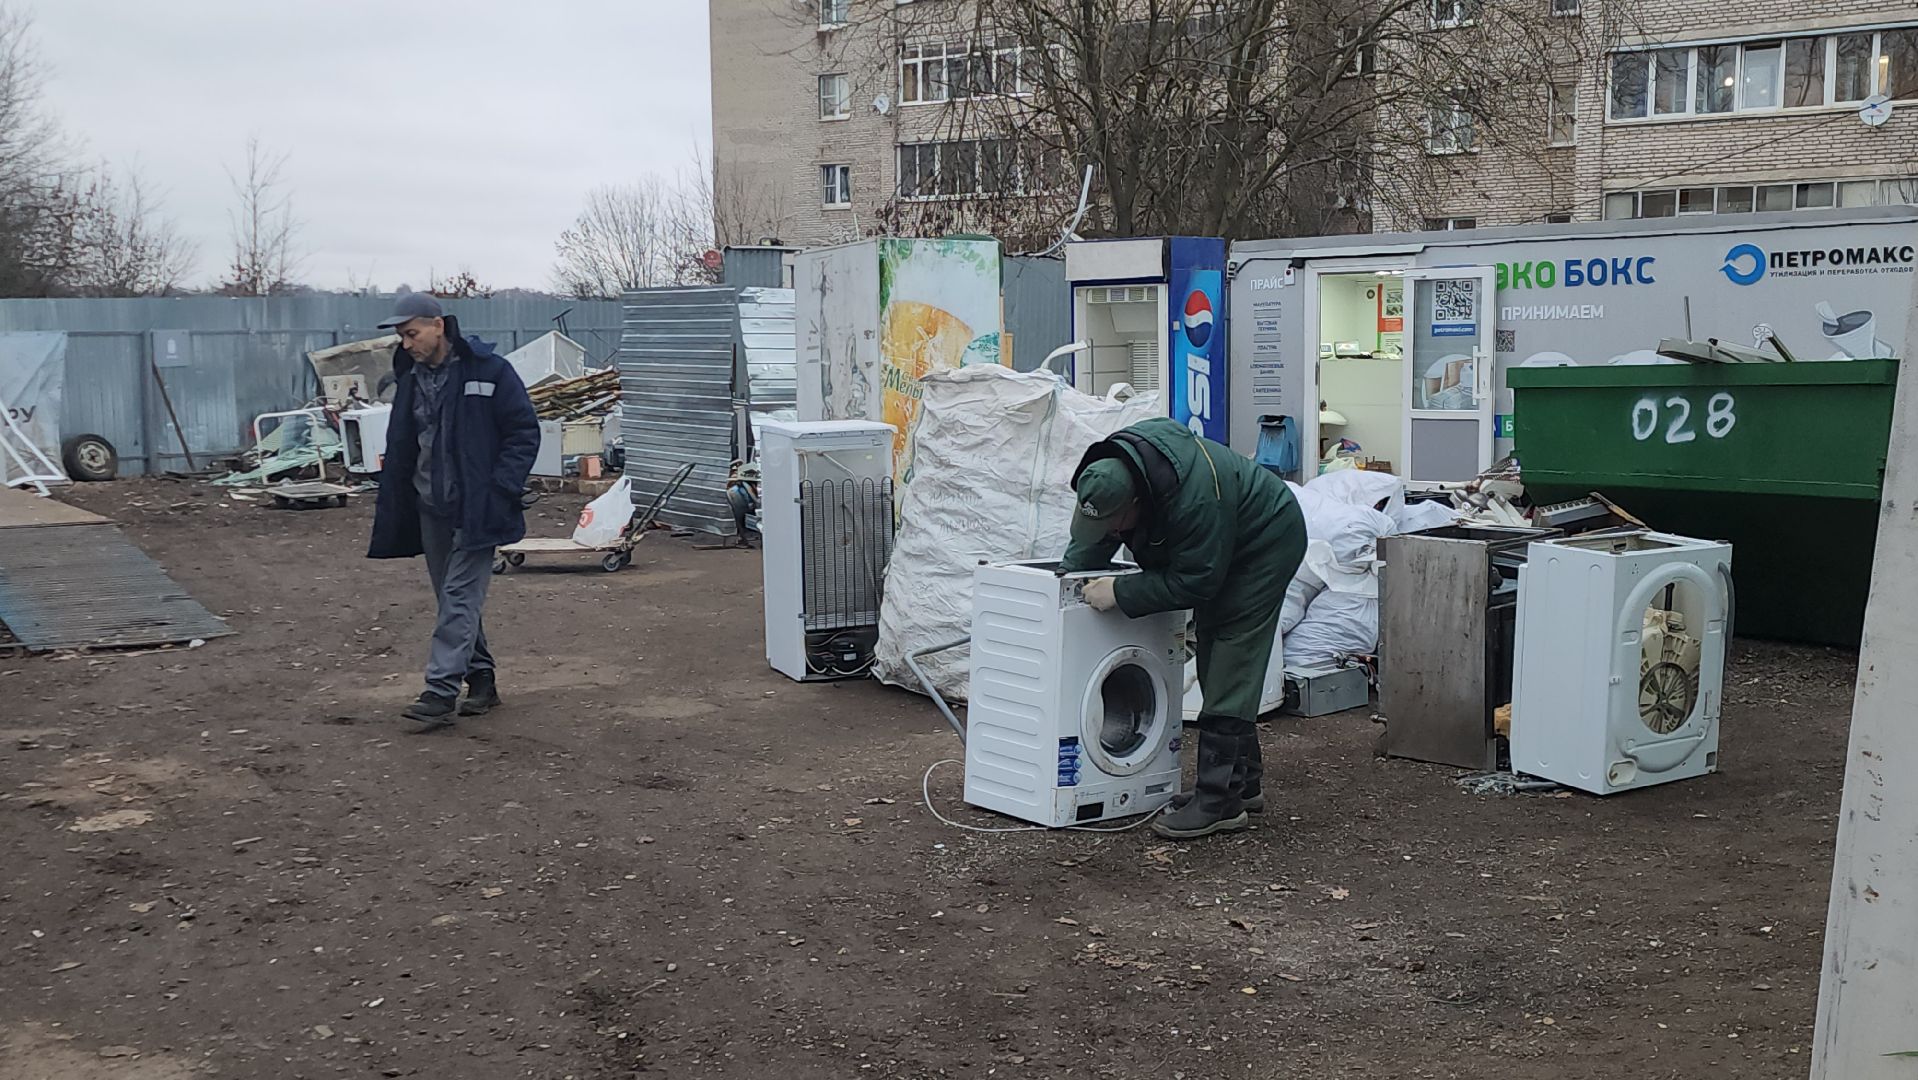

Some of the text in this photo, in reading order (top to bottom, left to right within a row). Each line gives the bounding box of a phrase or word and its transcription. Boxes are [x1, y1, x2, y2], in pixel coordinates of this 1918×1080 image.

[1770, 246, 1914, 268] ПЕТРОМАКС
[1564, 256, 1656, 287] БОКС
[1770, 270, 1817, 278] УТИЛИЗАЦИЯ
[1827, 268, 1878, 276] ПЕРЕРАБОТКА
[1881, 266, 1914, 274] ОТХОДОВ
[1250, 275, 1284, 290] ПРАЙС
[1501, 304, 1604, 321] ПРИНИМАЕМ
[1632, 393, 1736, 443] 028
